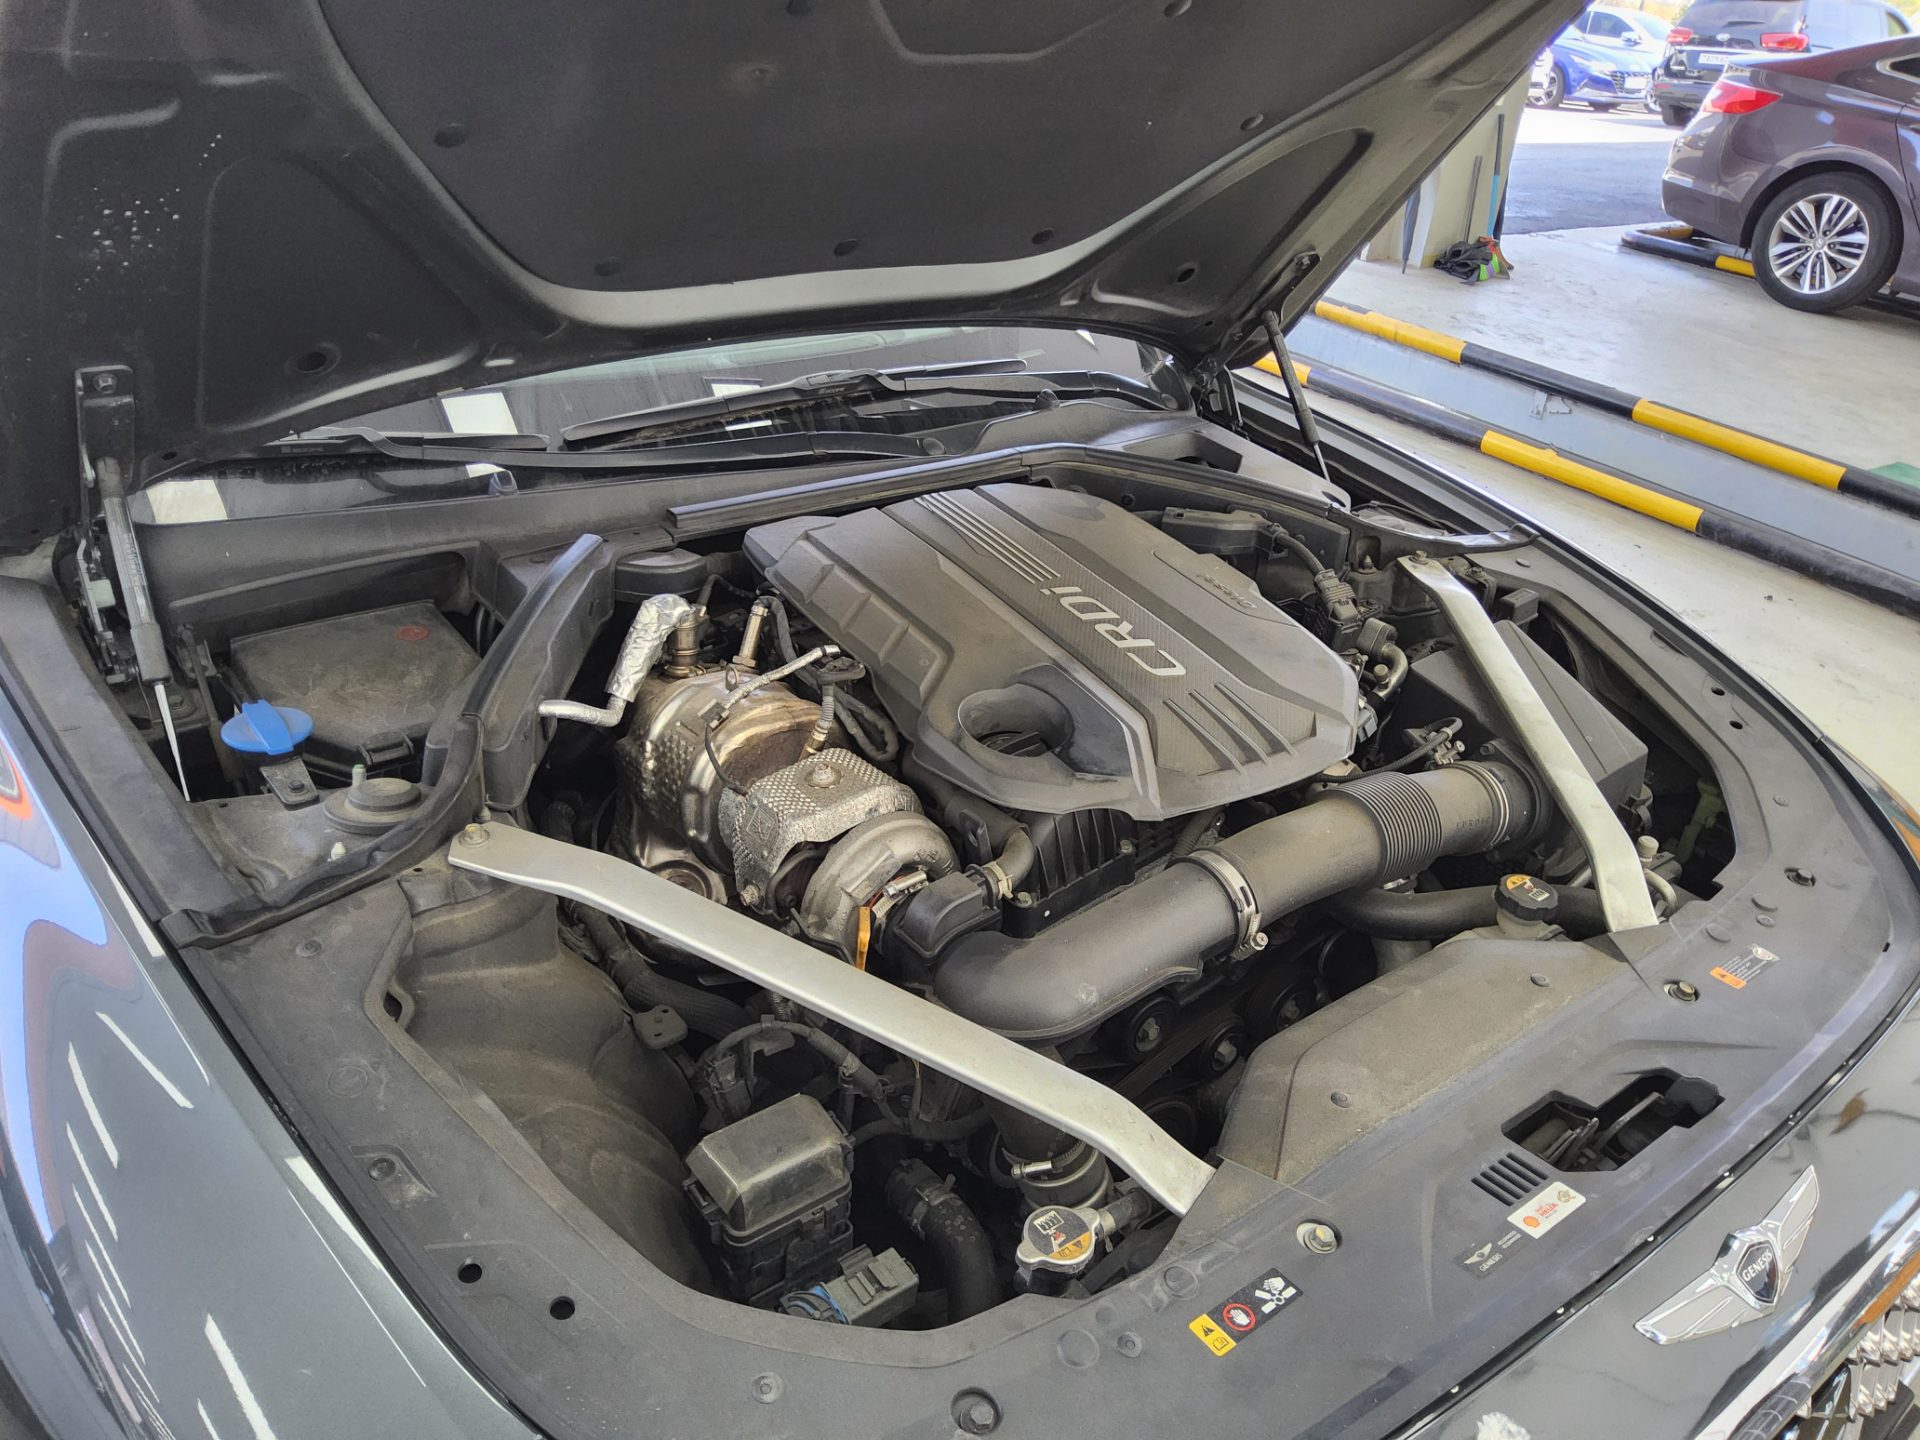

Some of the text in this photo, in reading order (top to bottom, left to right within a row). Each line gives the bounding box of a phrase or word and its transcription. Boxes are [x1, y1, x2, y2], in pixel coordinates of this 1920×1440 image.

[1039, 586, 1186, 676] CRDi
[1479, 1253, 1503, 1272] GENESIS
[1742, 1248, 1773, 1282] GENESIS
